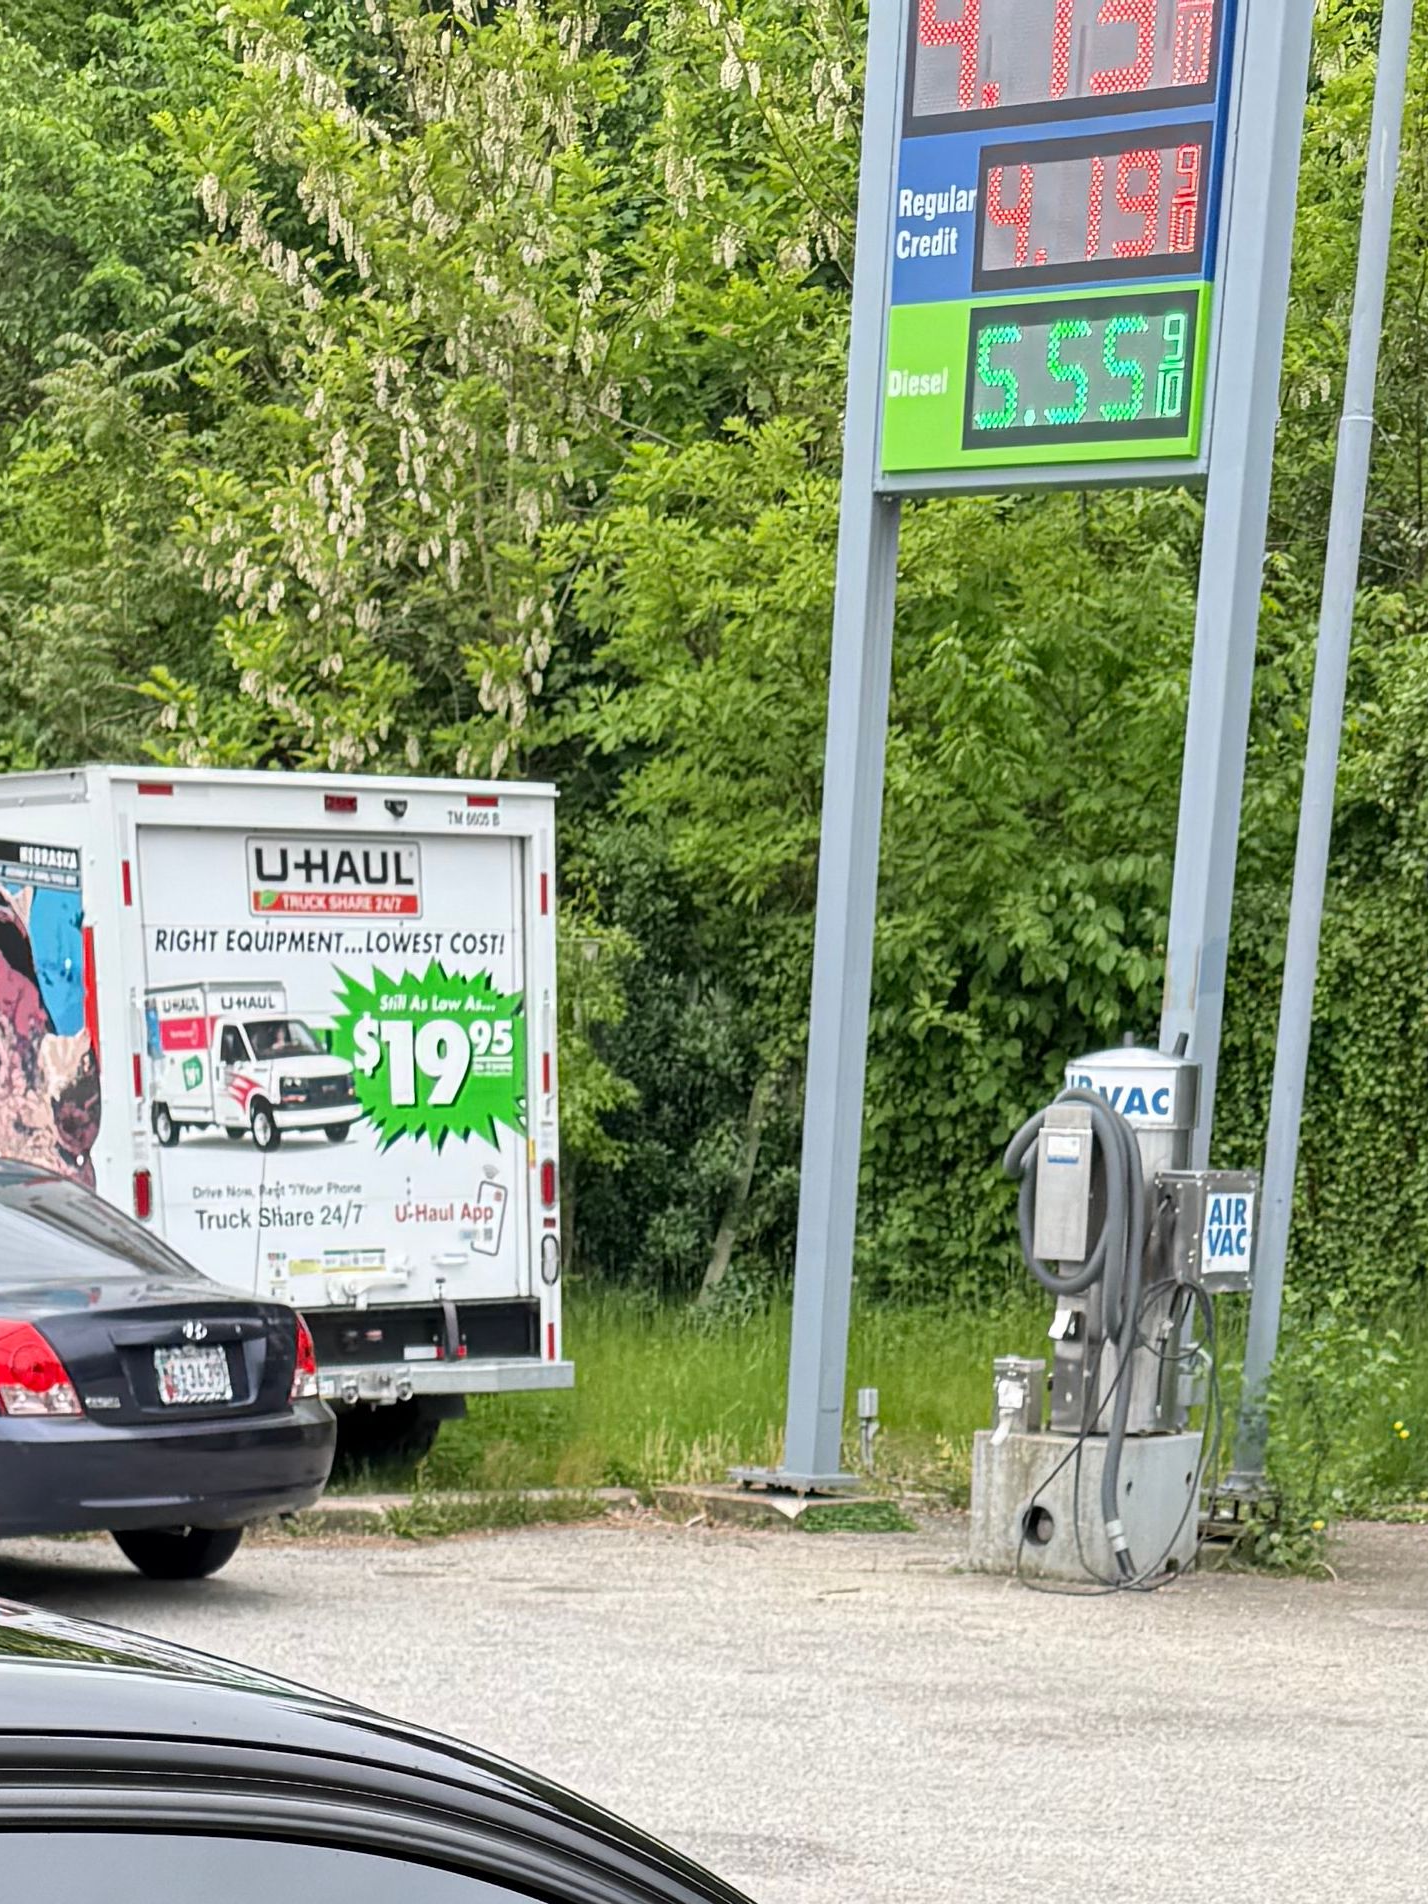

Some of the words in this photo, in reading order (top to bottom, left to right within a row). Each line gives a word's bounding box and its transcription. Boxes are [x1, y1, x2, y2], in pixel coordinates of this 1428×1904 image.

[899, 185, 977, 221] Regular
[987, 149, 1162, 266] 4.19
[896, 228, 958, 259] Credit
[887, 368, 948, 398] Diesel
[974, 315, 1149, 430] 5.55
[19, 846, 77, 869] NEBRASKA
[254, 848, 414, 885] U-HAUL
[282, 893, 327, 910] TRUCK
[328, 894, 373, 911] SHARE
[374, 895, 402, 911] 24/7
[155, 929, 219, 952] RIGHT
[450, 932, 505, 955] COST!
[220, 995, 275, 1010] U-HAUL
[379, 993, 407, 1012] Still
[409, 994, 429, 1012] As
[432, 994, 462, 1012] Low
[1099, 1086, 1170, 1116] VAC
[192, 1185, 223, 1200] Drive
[326, 1181, 362, 1195] Phone
[195, 1208, 253, 1231] Truck
[257, 1206, 314, 1228] Share
[319, 1199, 363, 1230] 24/7
[394, 1203, 454, 1223] U-Haul
[460, 1202, 494, 1224] App
[1208, 1198, 1248, 1227] AIR
[1206, 1227, 1248, 1258] VAC
